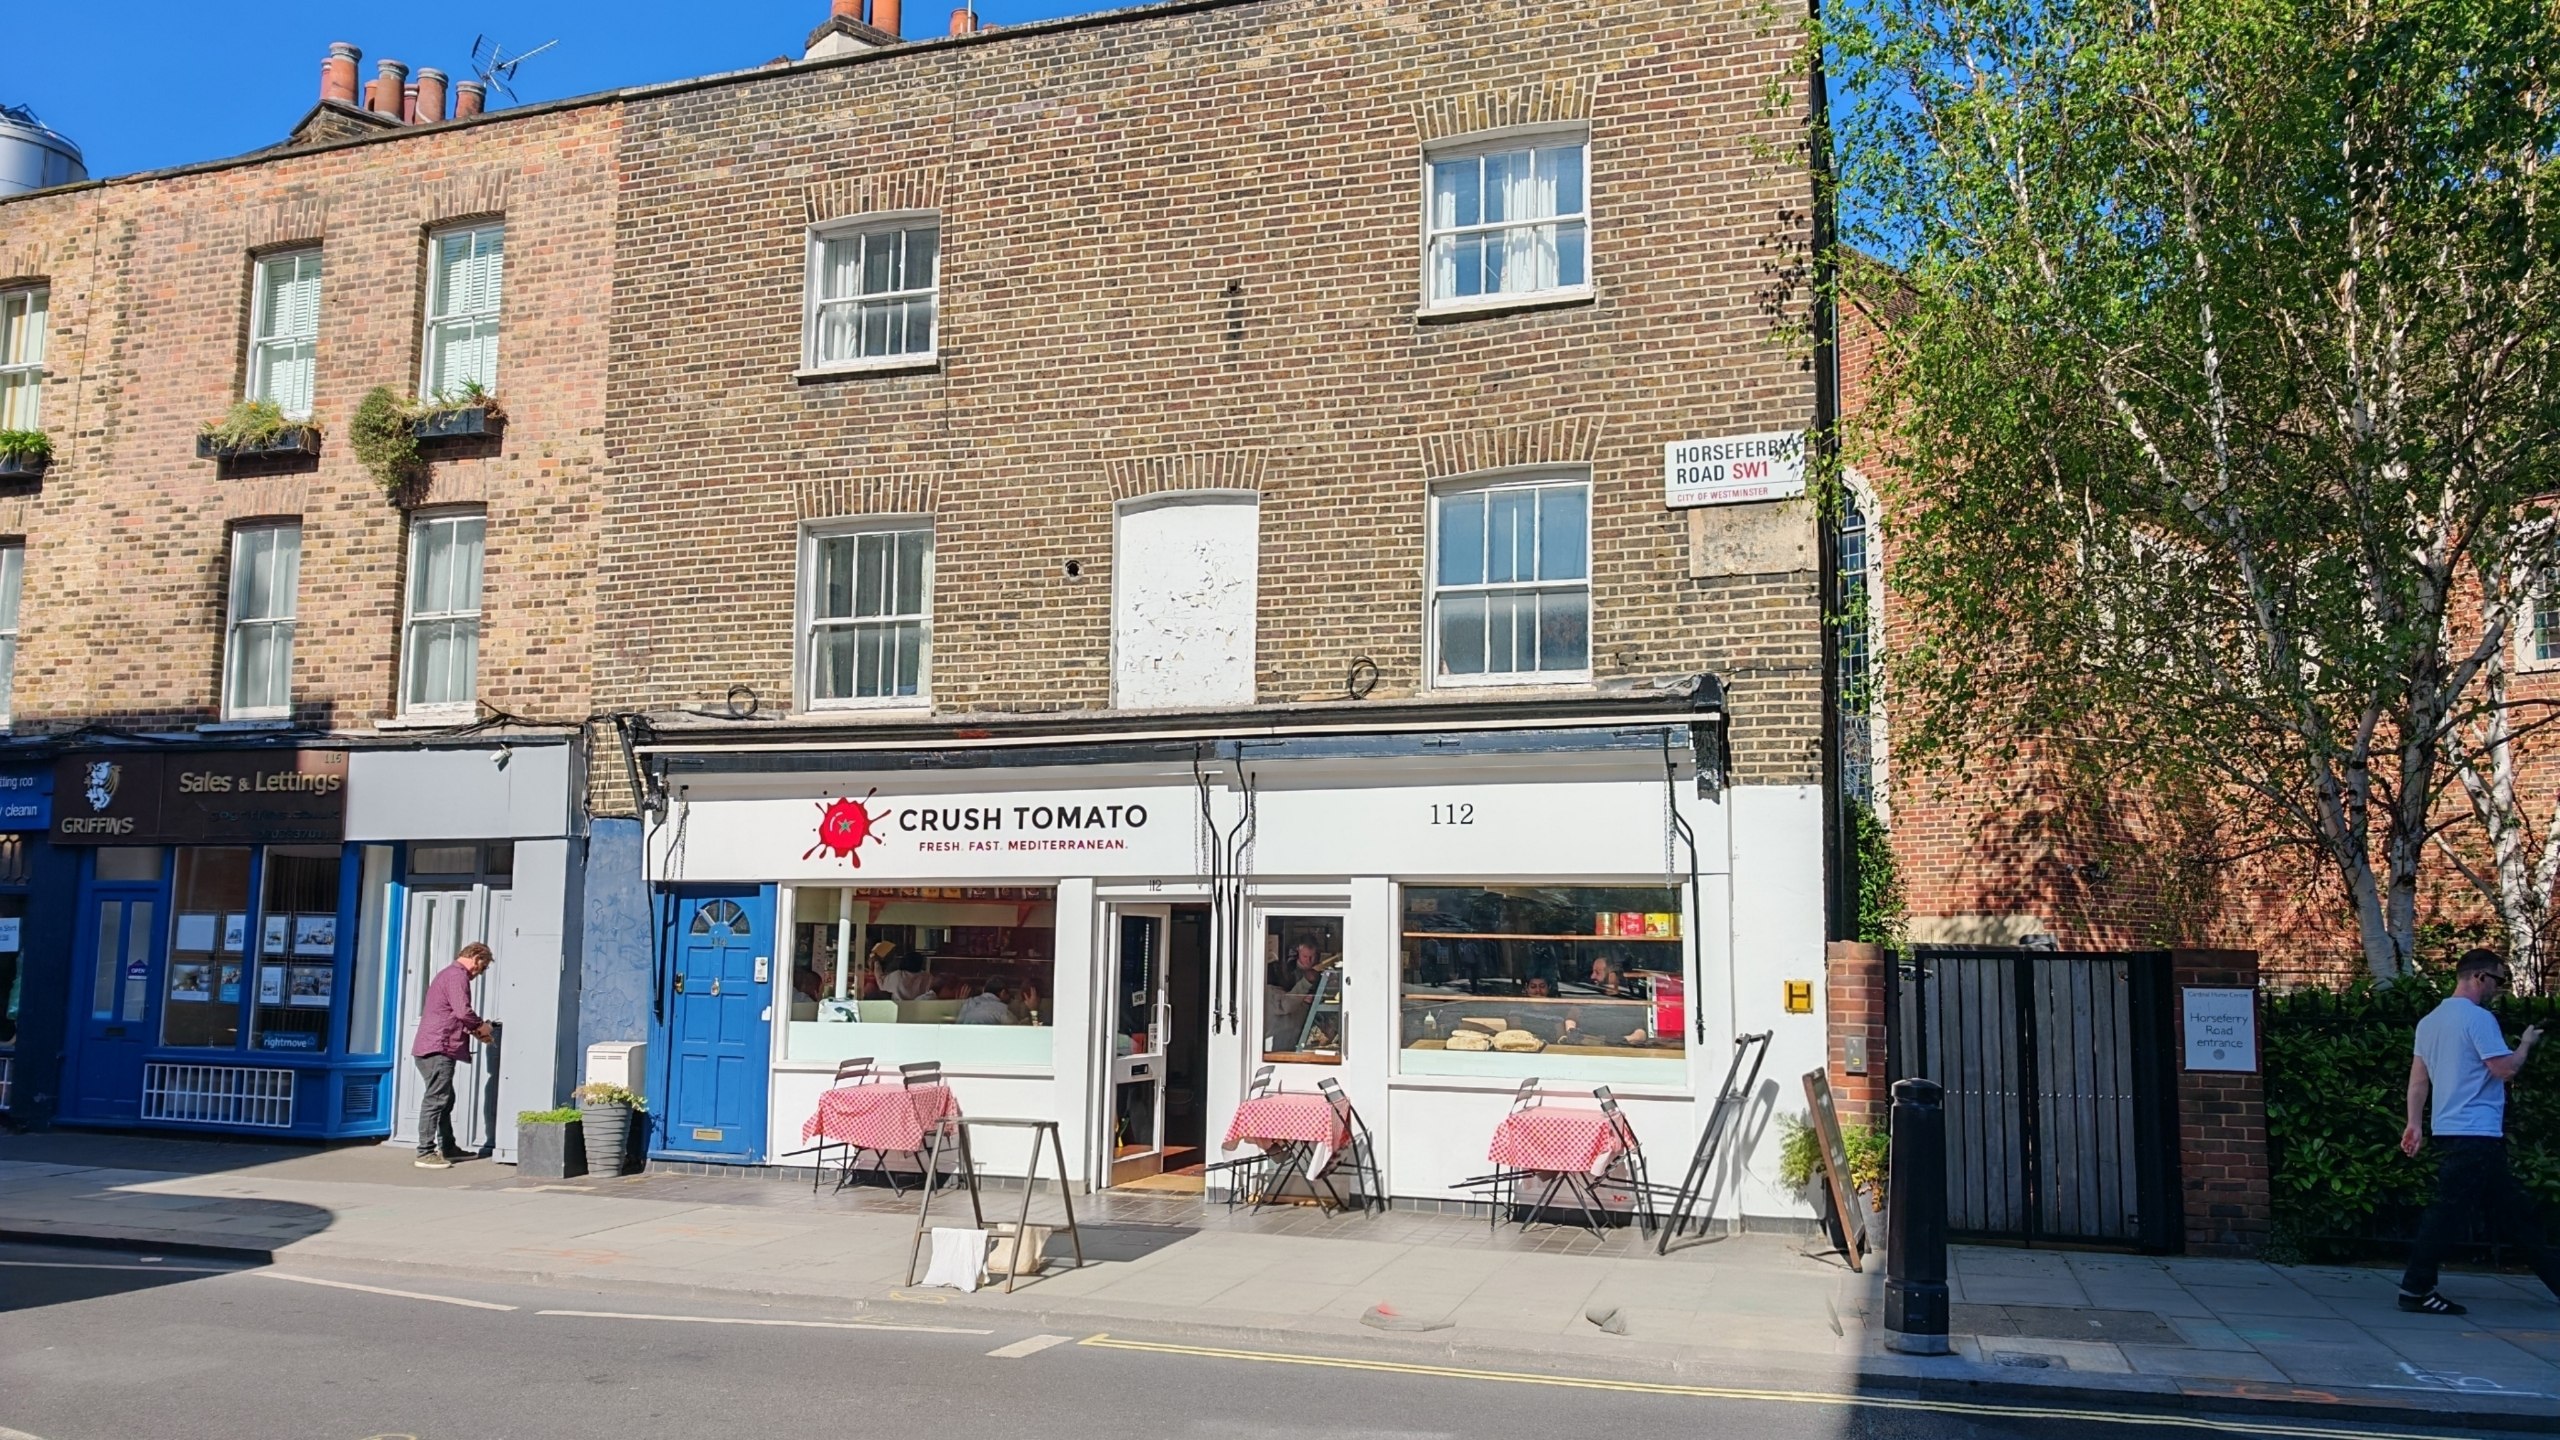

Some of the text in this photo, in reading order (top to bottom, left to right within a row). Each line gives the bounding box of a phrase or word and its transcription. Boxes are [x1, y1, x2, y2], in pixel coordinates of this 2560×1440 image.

[1677, 461, 1768, 485] ROAD SW1
[1677, 487, 1769, 503] CITY OF WESTMINSTER
[179, 770, 342, 796] Sales & Lettings
[899, 805, 1148, 832] CRUSH TOMATO
[1430, 803, 1474, 825] 112
[61, 817, 134, 835] GRIFFINS
[919, 839, 1128, 852] FRESH. FAST. MEDITERRANEAN.
[1149, 879, 1162, 892] 112
[1788, 983, 1811, 1009] H
[2190, 1012, 2248, 1026] Horseferry
[2205, 1025, 2233, 1036] Road
[264, 1036, 307, 1049] rightmove
[2196, 1039, 2244, 1048] entrance
